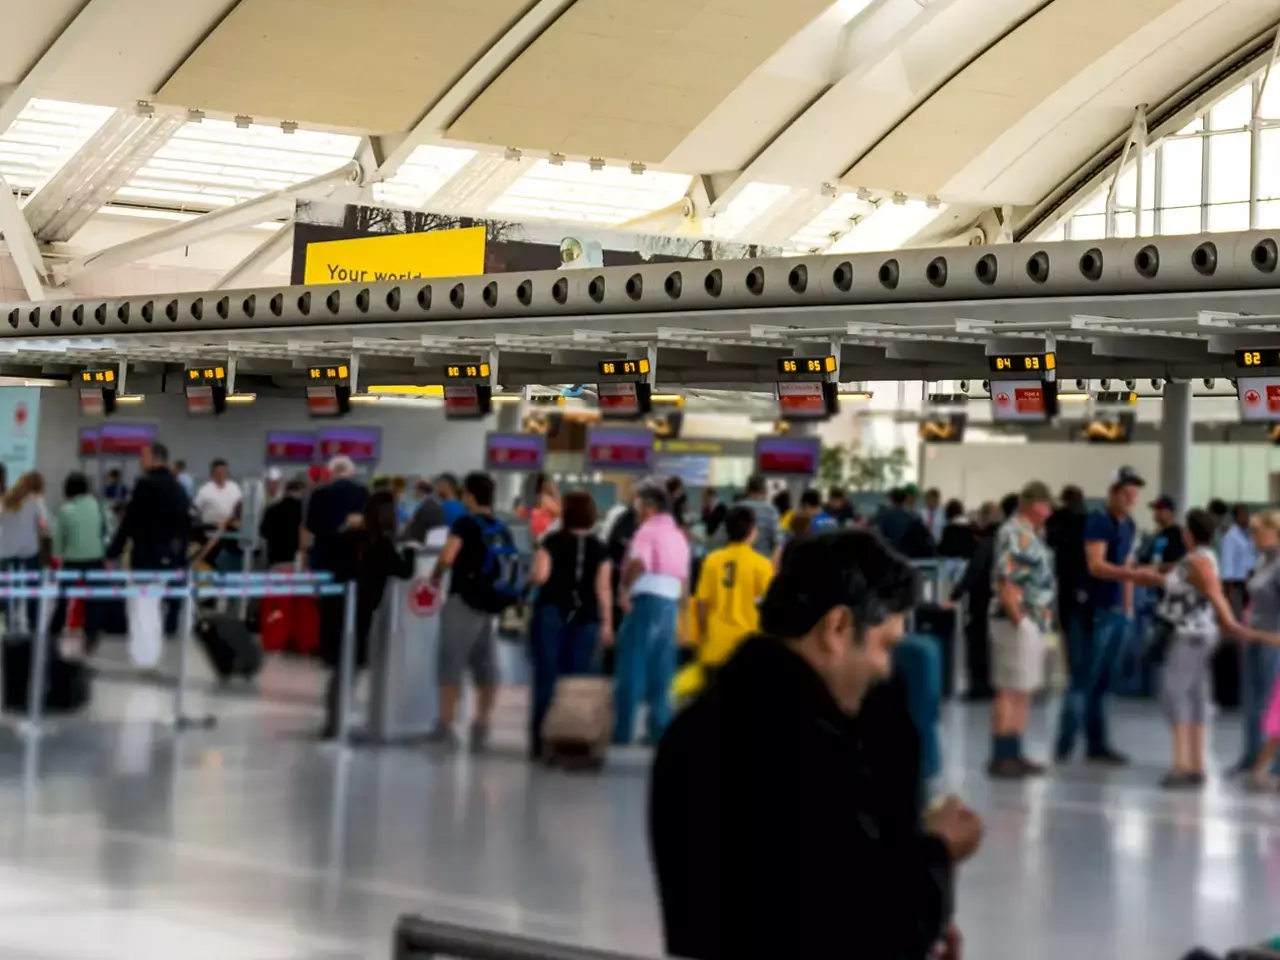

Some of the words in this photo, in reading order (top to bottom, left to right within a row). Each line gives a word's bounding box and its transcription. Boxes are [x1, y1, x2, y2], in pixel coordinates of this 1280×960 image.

[327, 263, 368, 282] Your
[996, 357, 1011, 370] B4
[1024, 356, 1040, 369] B3
[1243, 351, 1261, 366] B2
[783, 360, 797, 372] B6
[808, 360, 821, 372] B5
